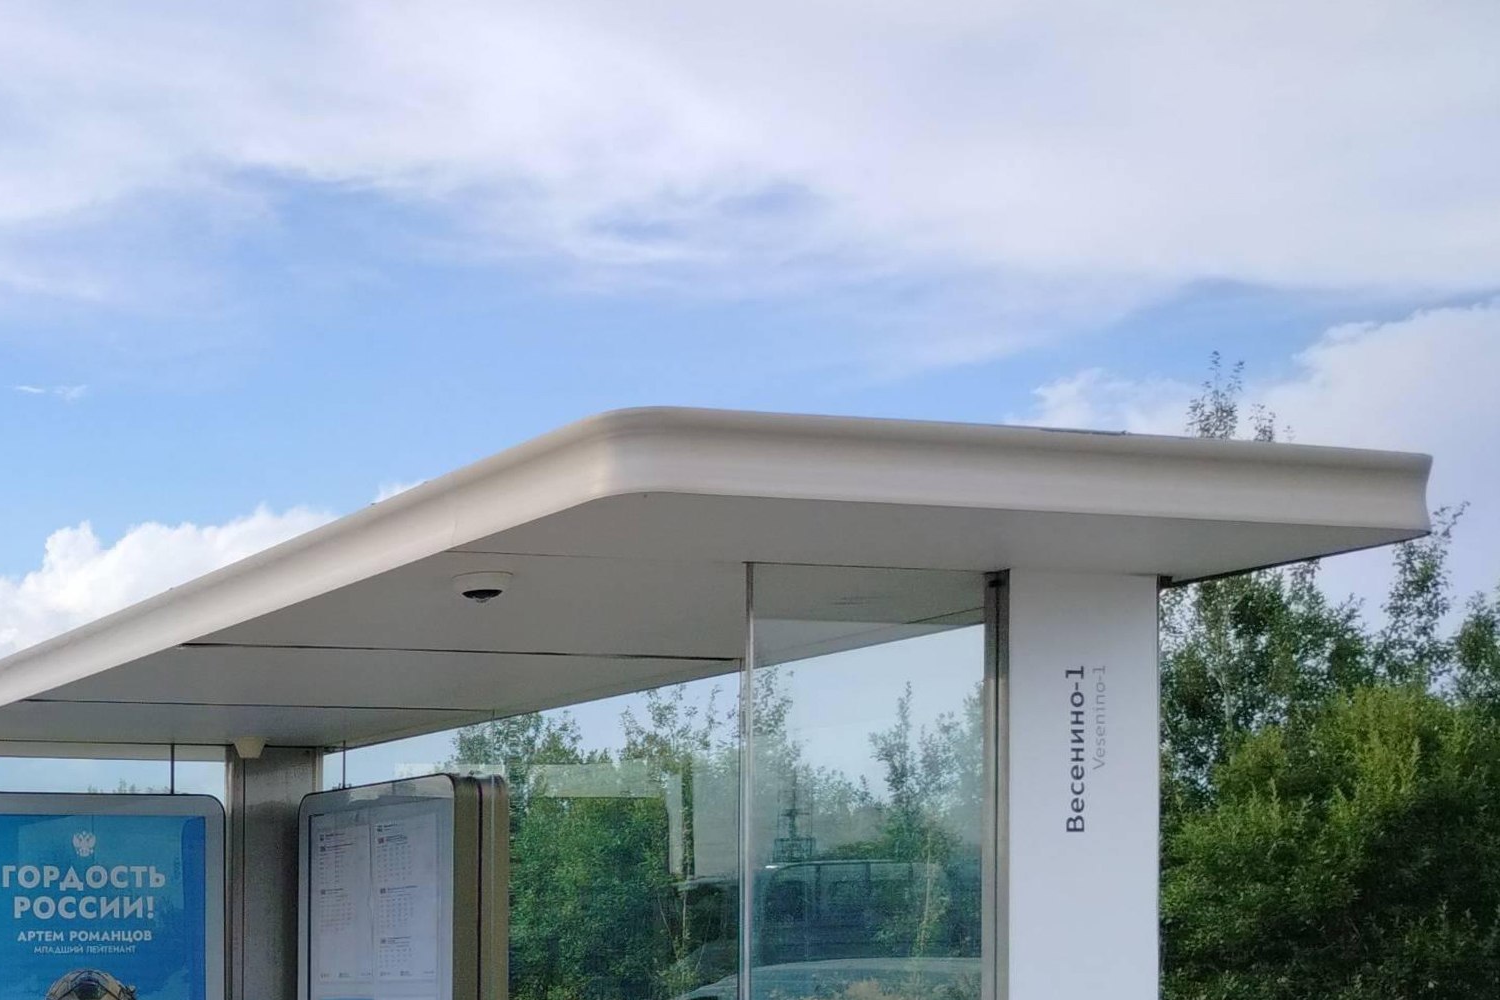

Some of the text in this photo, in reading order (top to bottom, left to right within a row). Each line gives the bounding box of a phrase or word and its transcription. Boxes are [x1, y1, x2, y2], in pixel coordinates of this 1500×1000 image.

[1092, 664, 1106, 770] Vesenino-1
[1065, 665, 1085, 833] Весенино-1
[2, 865, 166, 891] ГОРДОСТЬ
[13, 896, 155, 920] РОССИИ!
[17, 930, 152, 943] АРТЕМ РОМАНЦОВ
[34, 944, 136, 954] МЛАДШИЙ ЛЕЙТЕНАНТ
